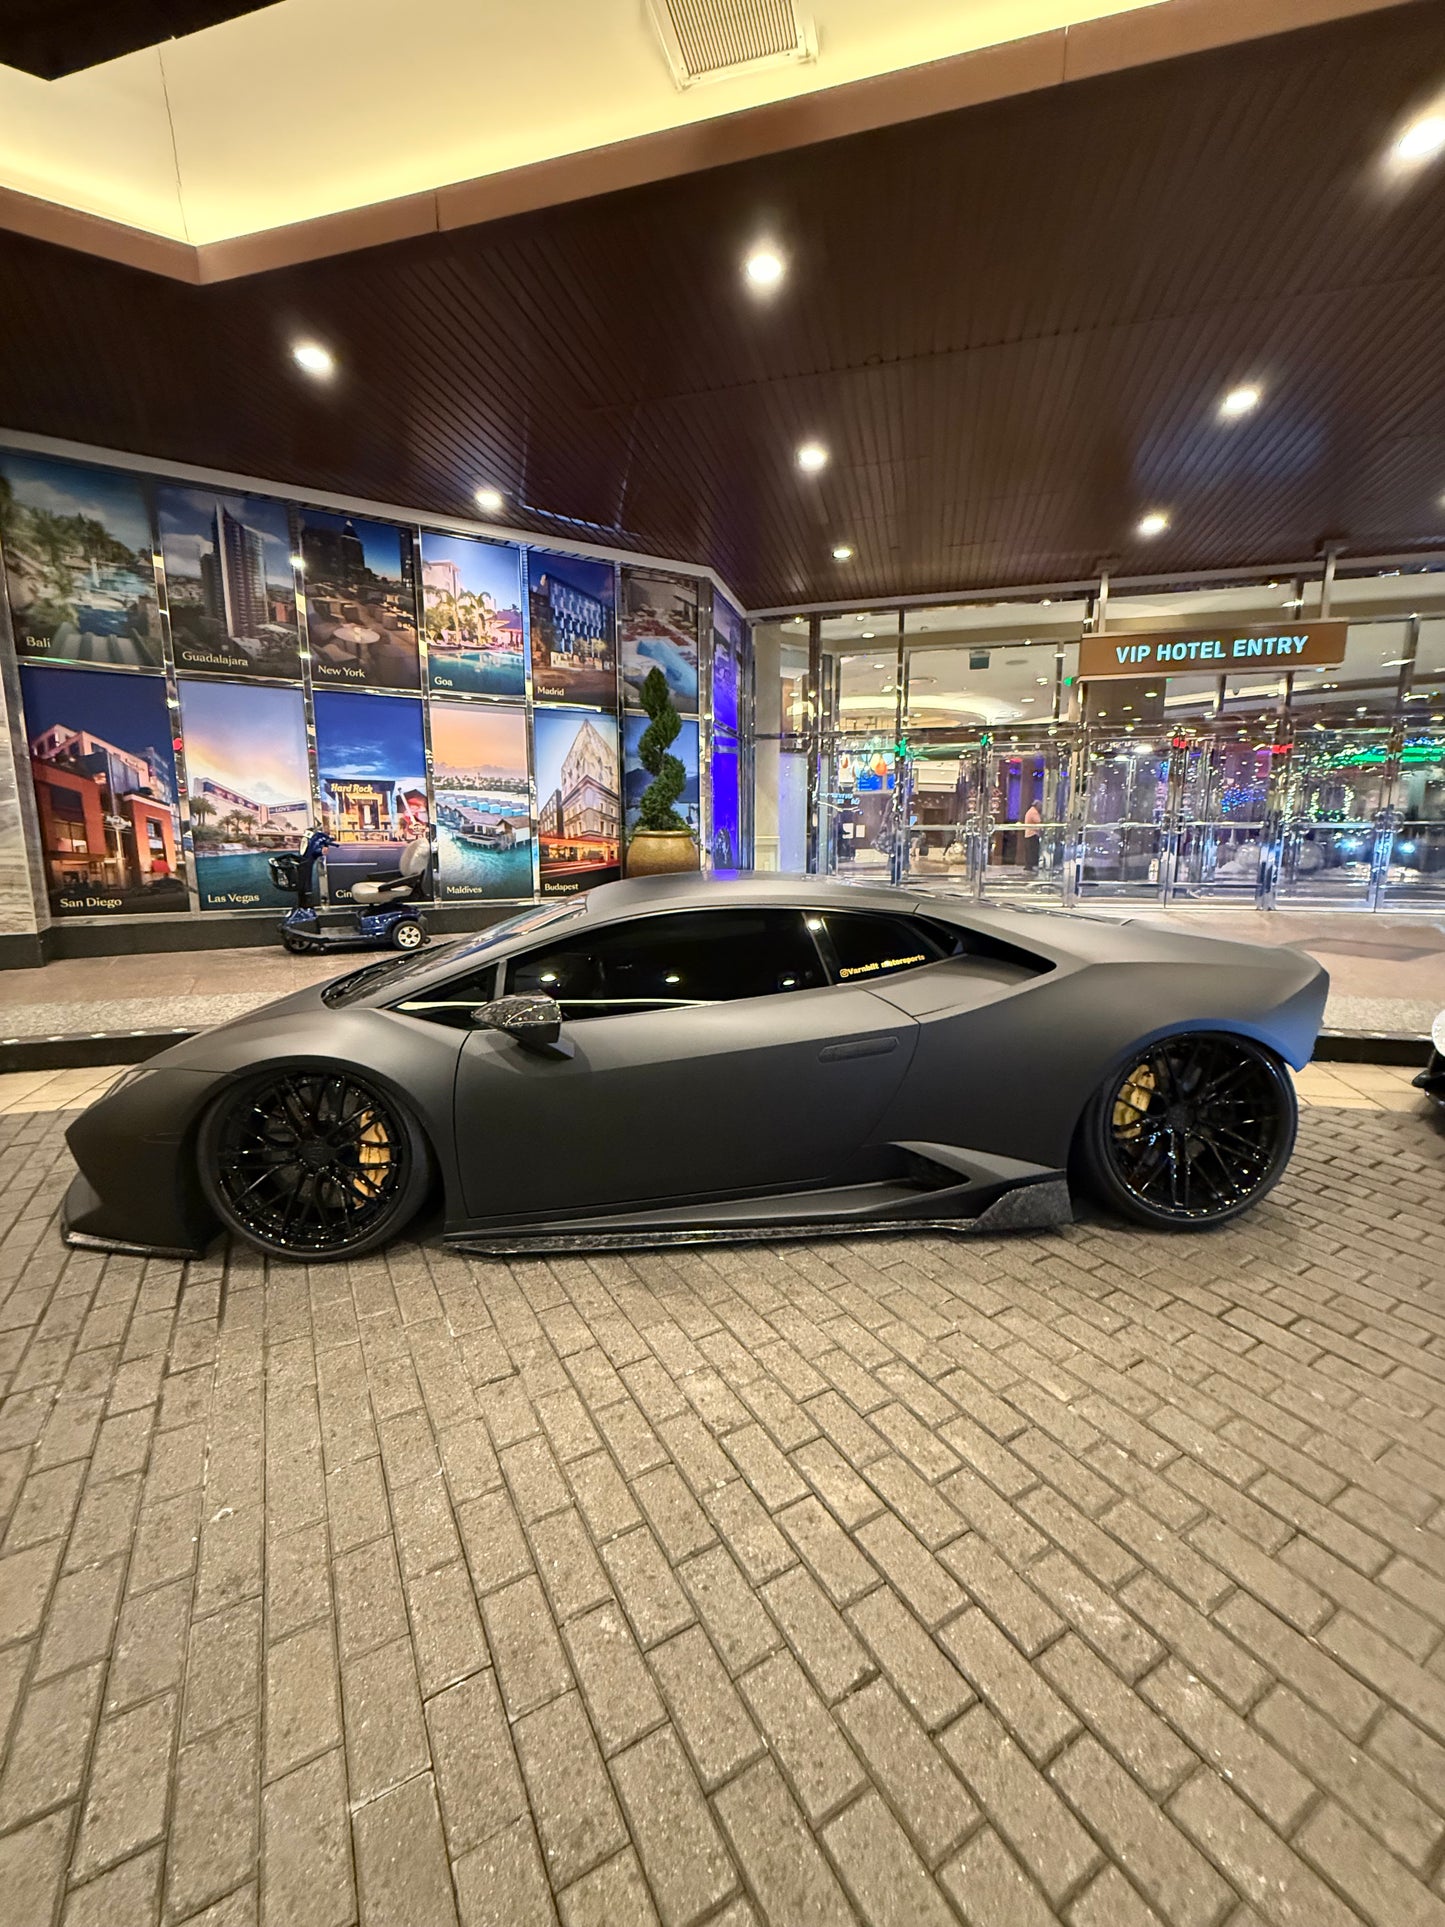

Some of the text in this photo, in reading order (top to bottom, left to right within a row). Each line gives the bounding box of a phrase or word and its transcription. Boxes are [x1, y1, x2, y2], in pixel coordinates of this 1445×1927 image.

[26, 636, 51, 648] Bali
[1116, 635, 1309, 664] VIP HOTEL ENTRY
[182, 651, 249, 667] Guadalajara
[318, 664, 366, 678] New York
[434, 676, 453, 687] Goa
[537, 686, 565, 696] Madrid
[330, 783, 374, 793] Hard Rock
[446, 886, 483, 894] Maldives
[544, 883, 579, 892] Budapest
[207, 893, 260, 905] Las Vegas
[335, 889, 353, 899] Cin
[60, 897, 123, 909] San Diego
